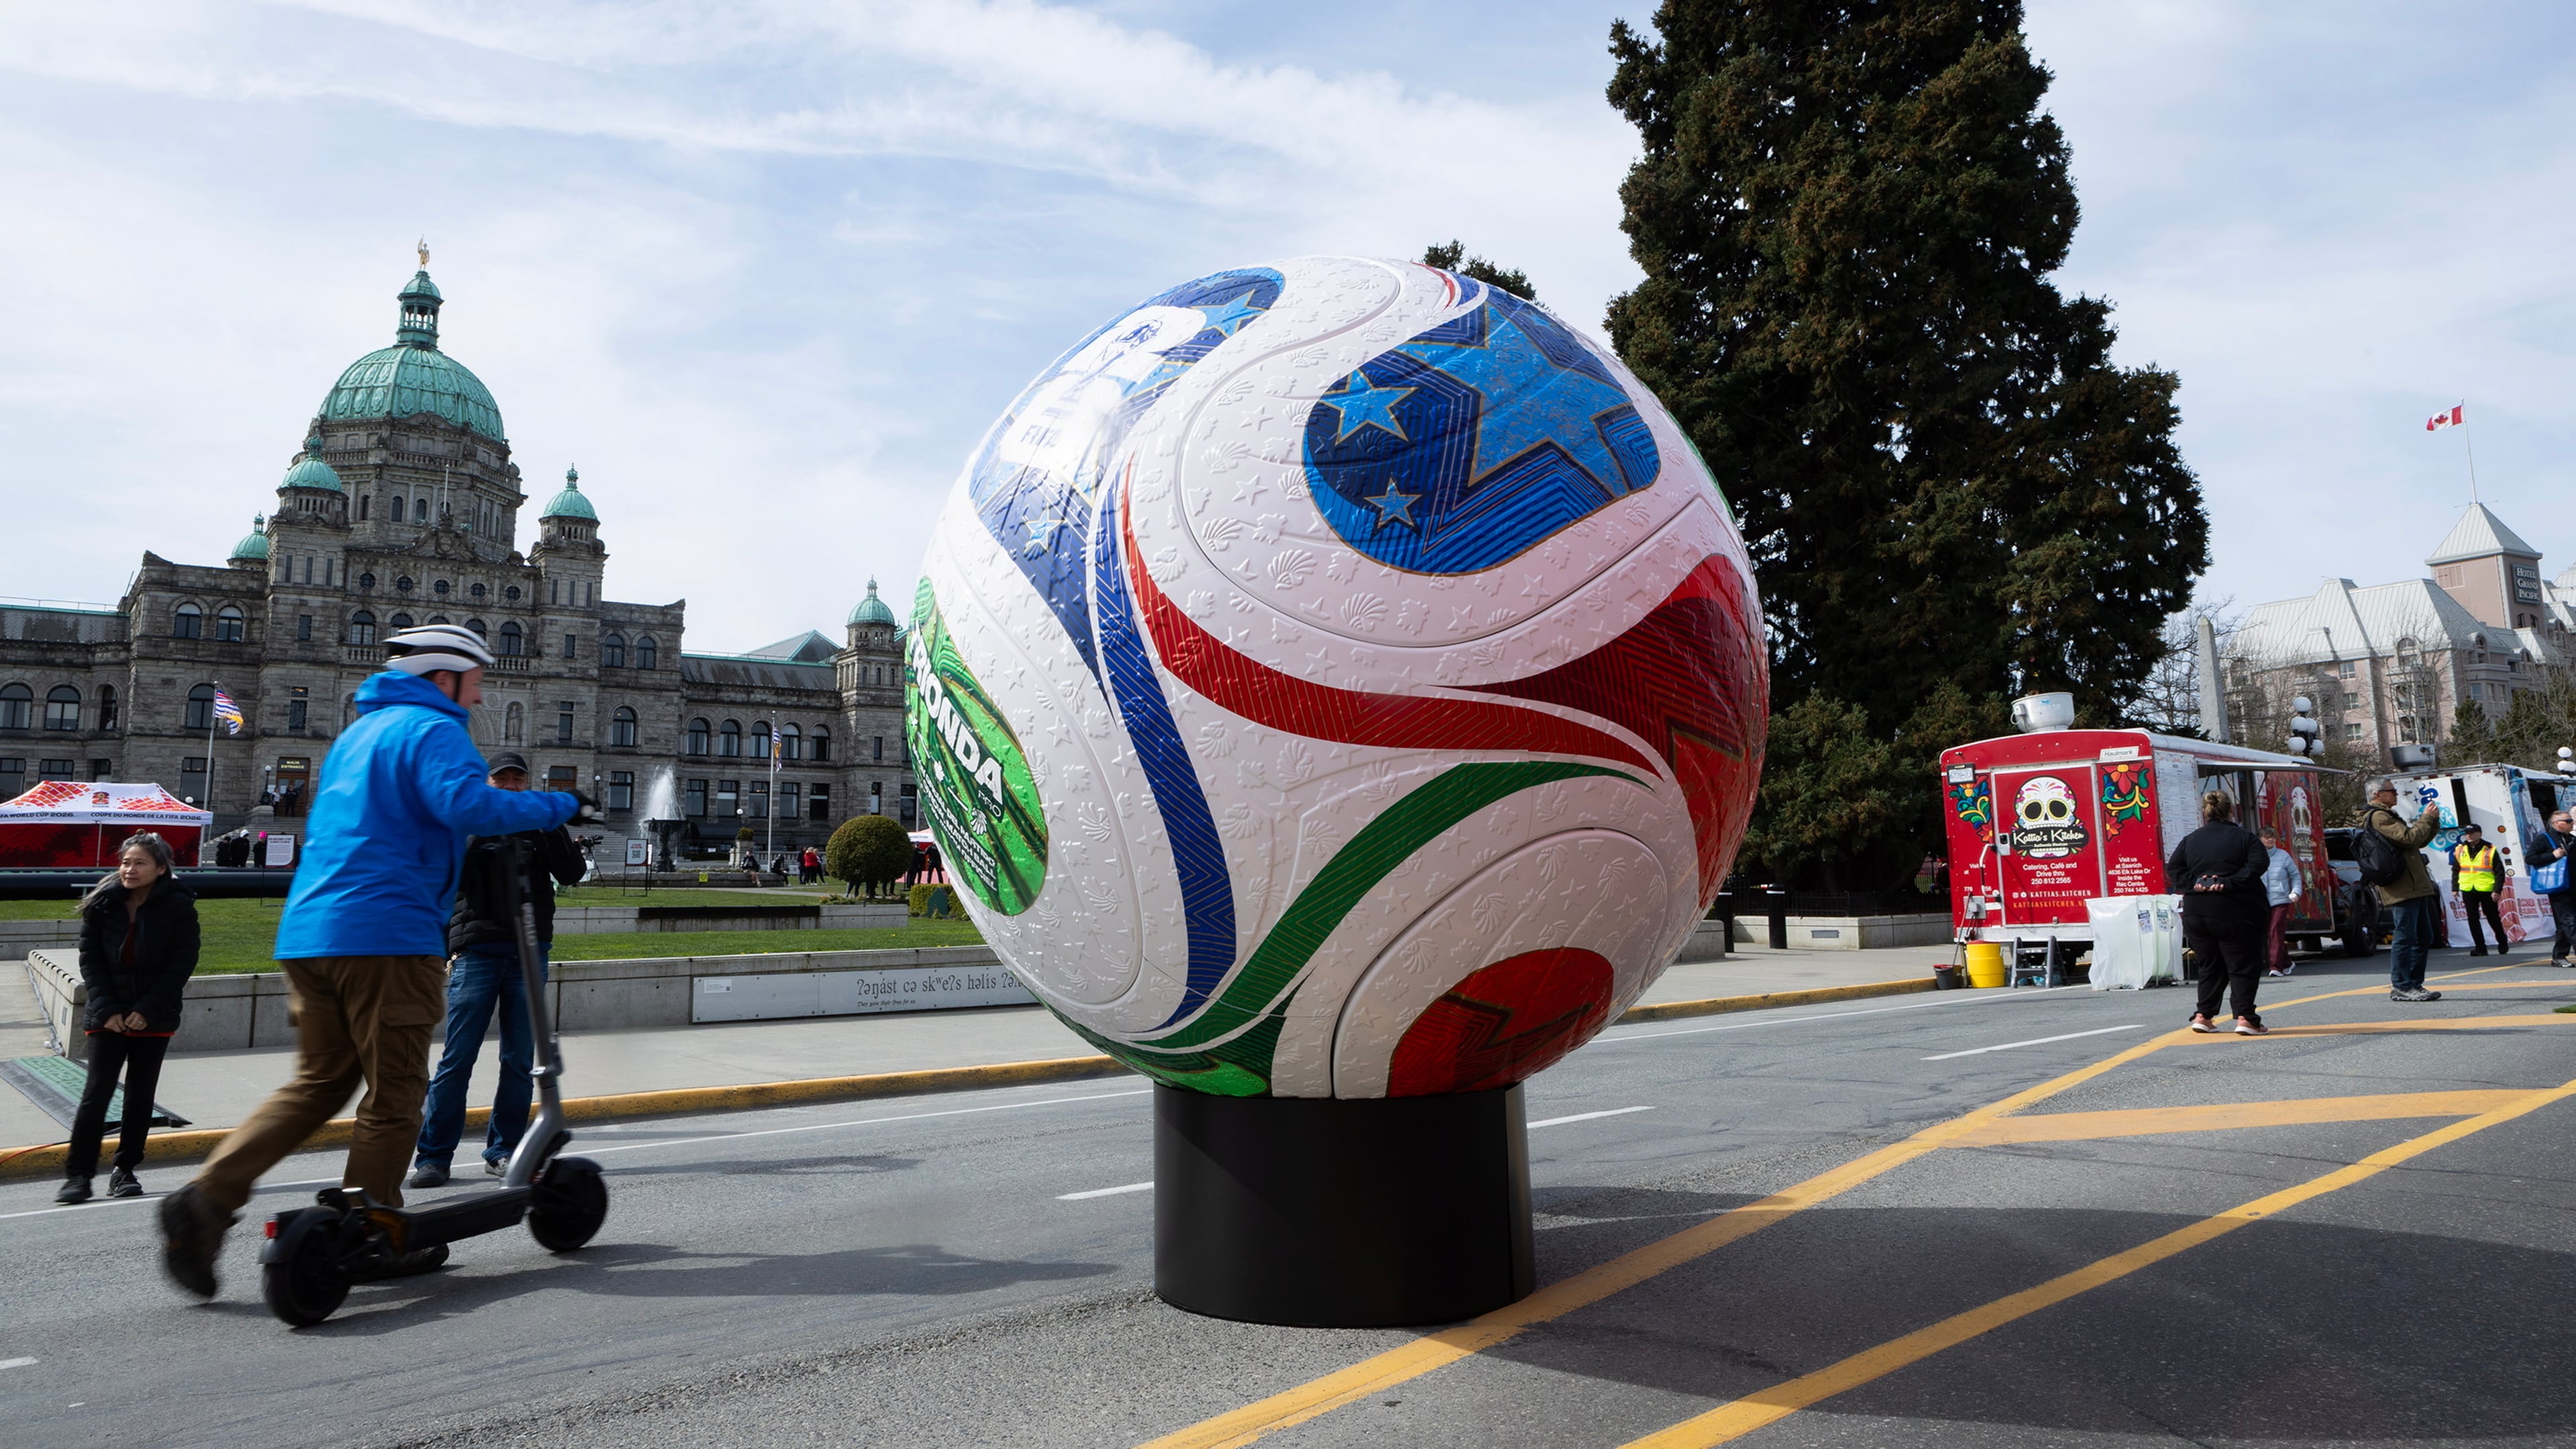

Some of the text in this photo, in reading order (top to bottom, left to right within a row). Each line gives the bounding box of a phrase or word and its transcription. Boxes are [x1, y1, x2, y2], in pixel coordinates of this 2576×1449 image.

[2516, 568, 2536, 578] HOTEL
[2517, 579, 2538, 590] GRAND
[978, 788, 1002, 818] PRO
[2012, 828, 2085, 845] Kattia's Kitchen
[973, 852, 997, 879] BALL
[2030, 890, 2091, 898] KATTIAS.KITCHEN
